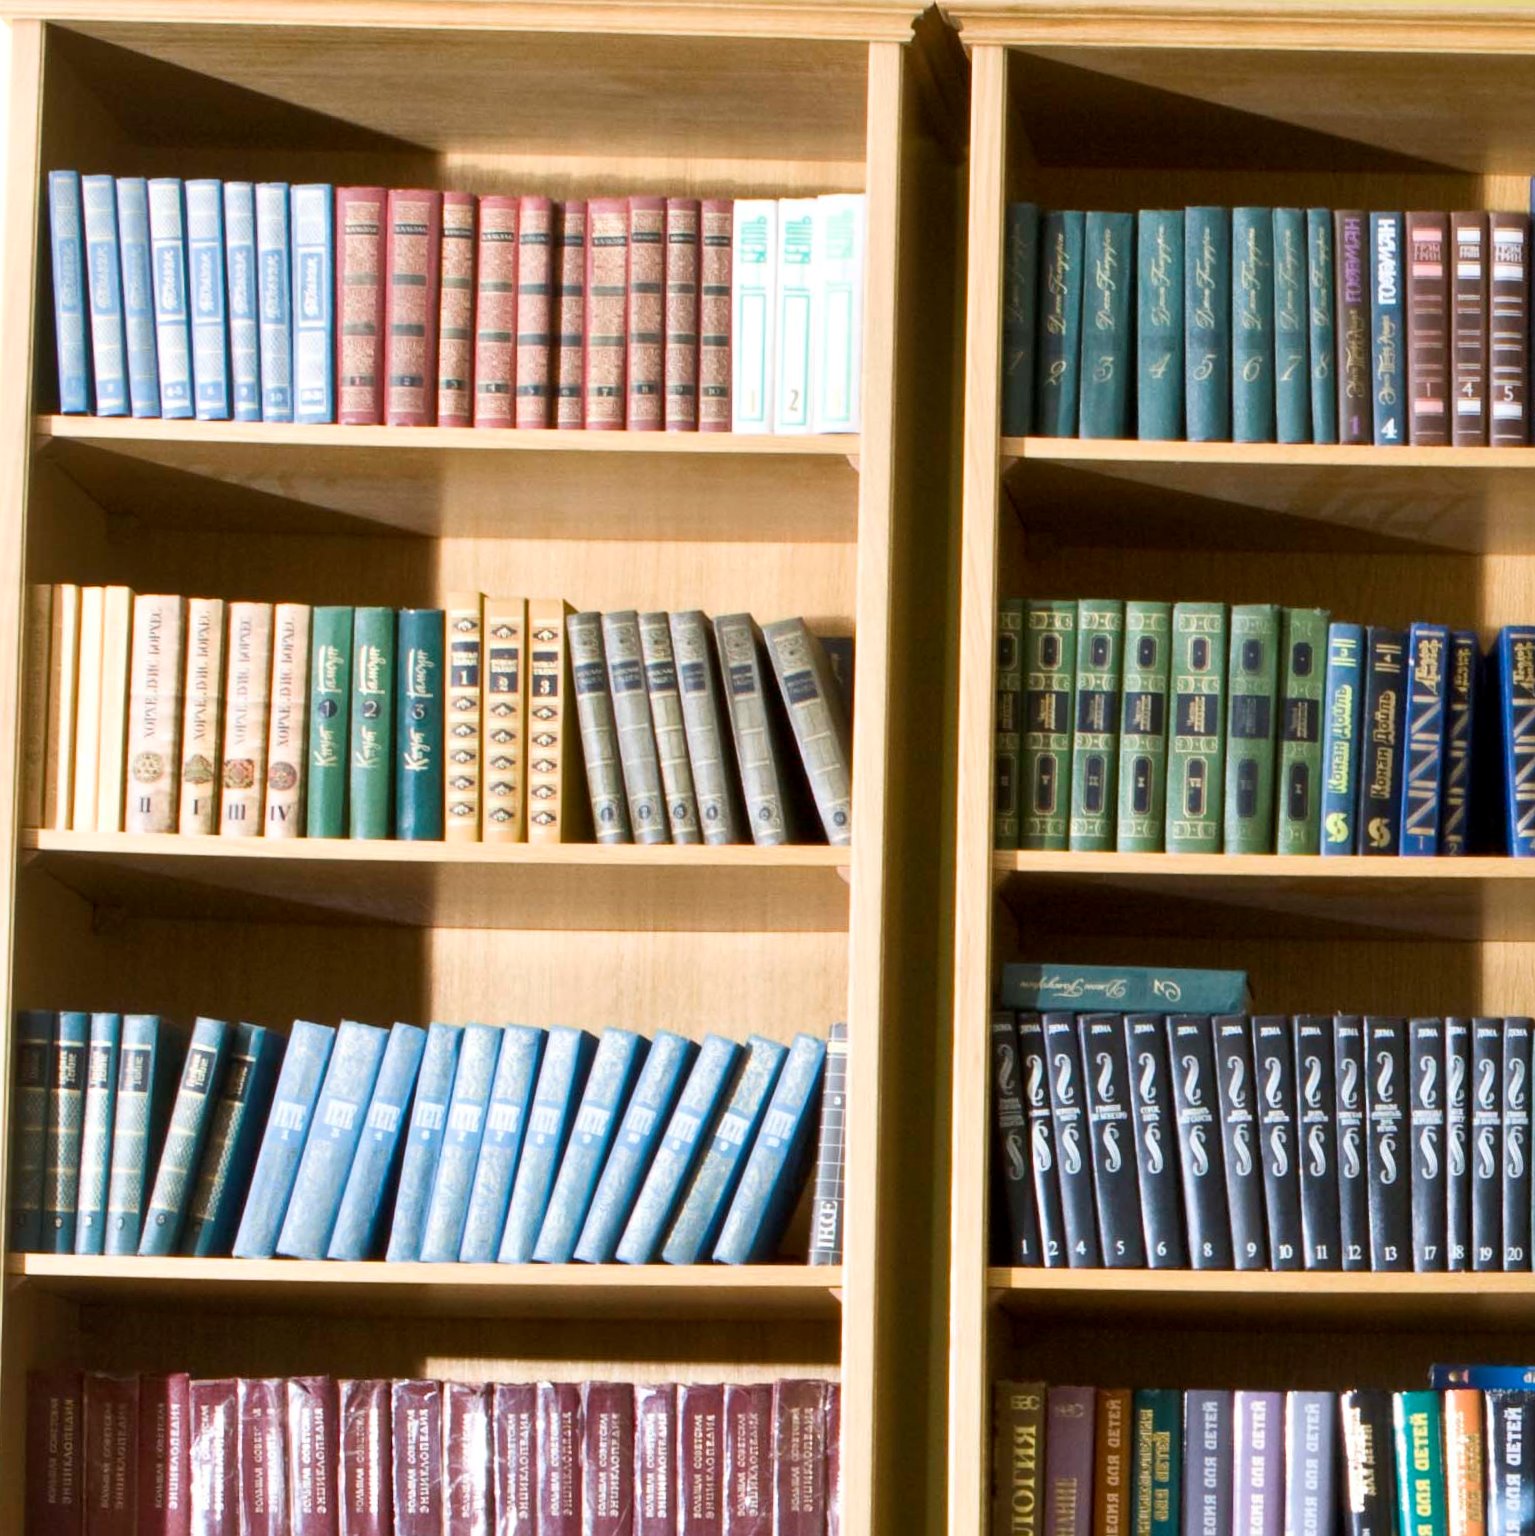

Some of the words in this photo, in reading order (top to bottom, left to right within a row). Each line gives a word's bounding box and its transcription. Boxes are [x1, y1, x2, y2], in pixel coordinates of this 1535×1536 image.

[1504, 386, 1514, 400] 5
[1382, 419, 1397, 439] 4
[411, 702, 424, 719] 3
[1374, 690, 1396, 745] Дойль
[1370, 747, 1389, 798] Конан
[139, 796, 151, 814] II
[270, 804, 289, 821] IV
[1117, 1241, 1125, 1255] 5
[1204, 1401, 1219, 1450] ДЕТЕЙ
[1412, 1411, 1429, 1472] ДЕТЕЙ
[1417, 1479, 1431, 1518] ДЛЯ
